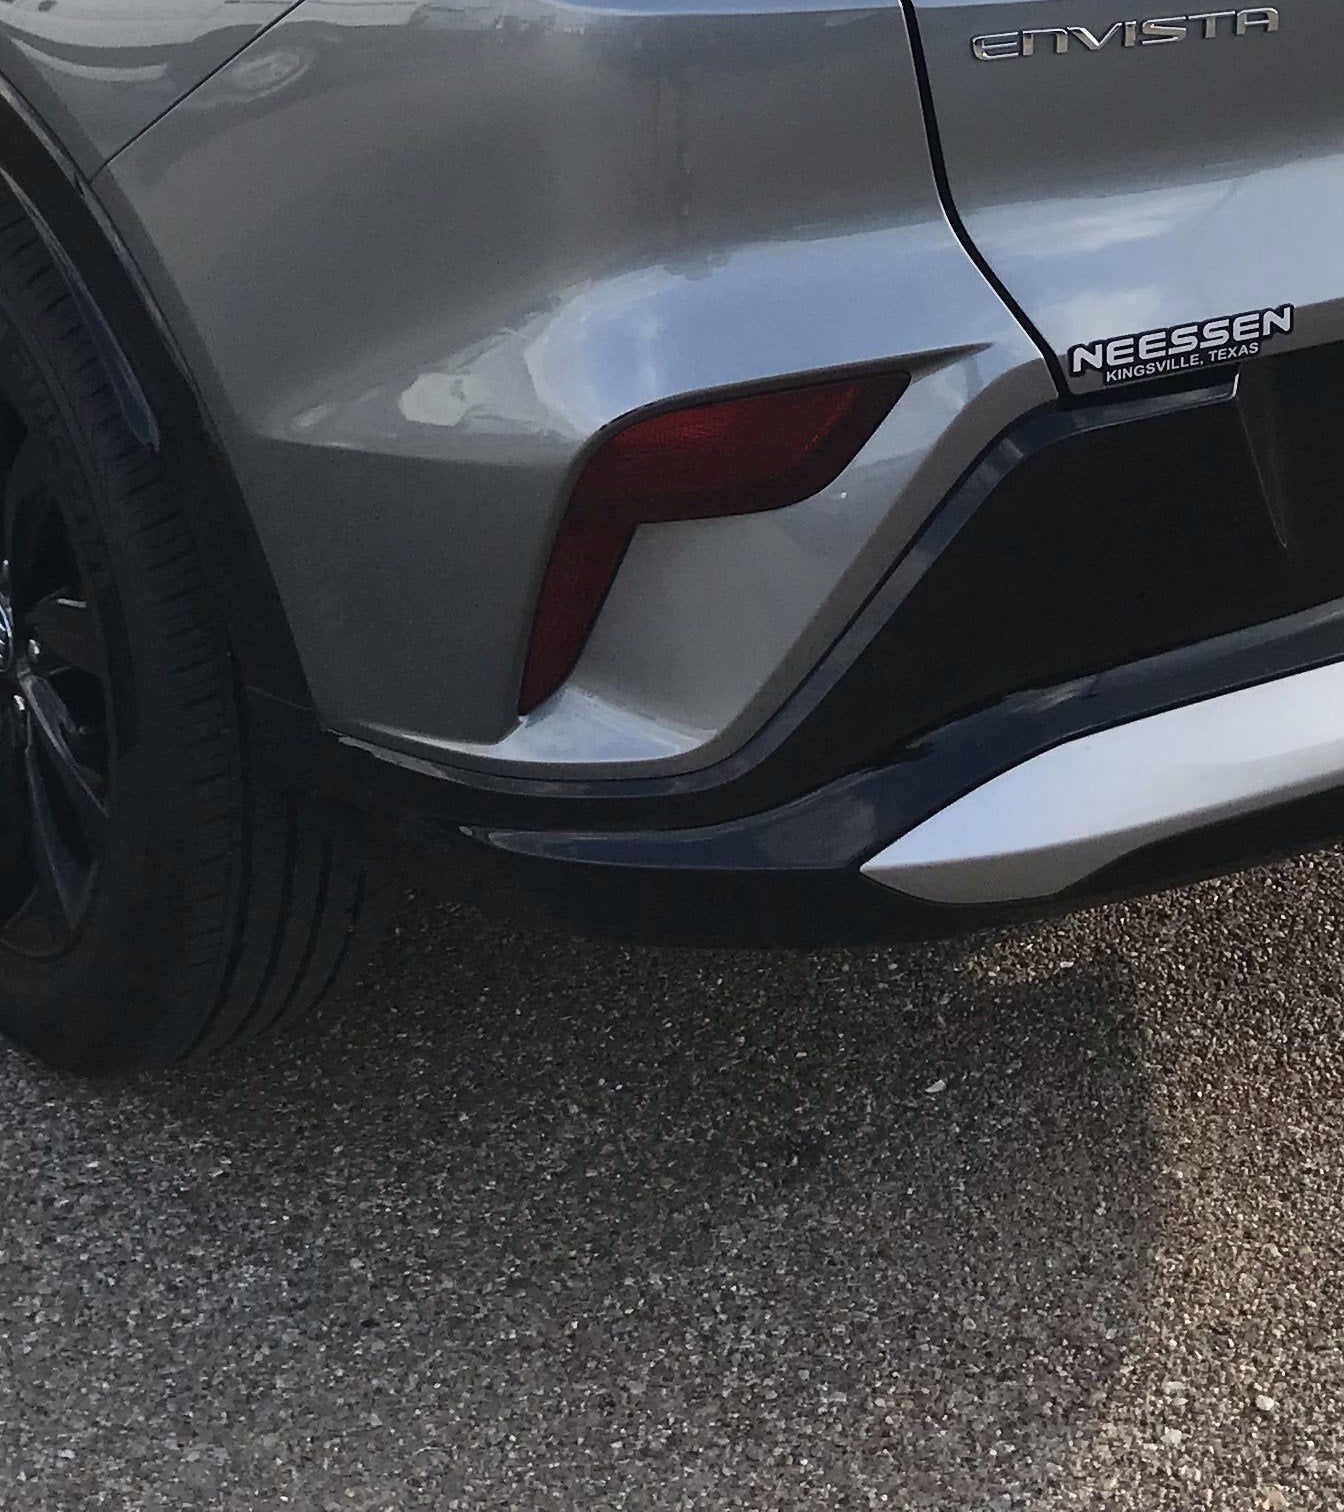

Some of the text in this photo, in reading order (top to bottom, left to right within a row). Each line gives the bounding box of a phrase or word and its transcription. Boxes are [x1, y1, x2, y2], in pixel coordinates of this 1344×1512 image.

[972, 7, 1279, 61] ENVISTA
[1073, 306, 1292, 374] NEESSEN
[1106, 341, 1260, 383] KINGSVILLE, TEXAS
